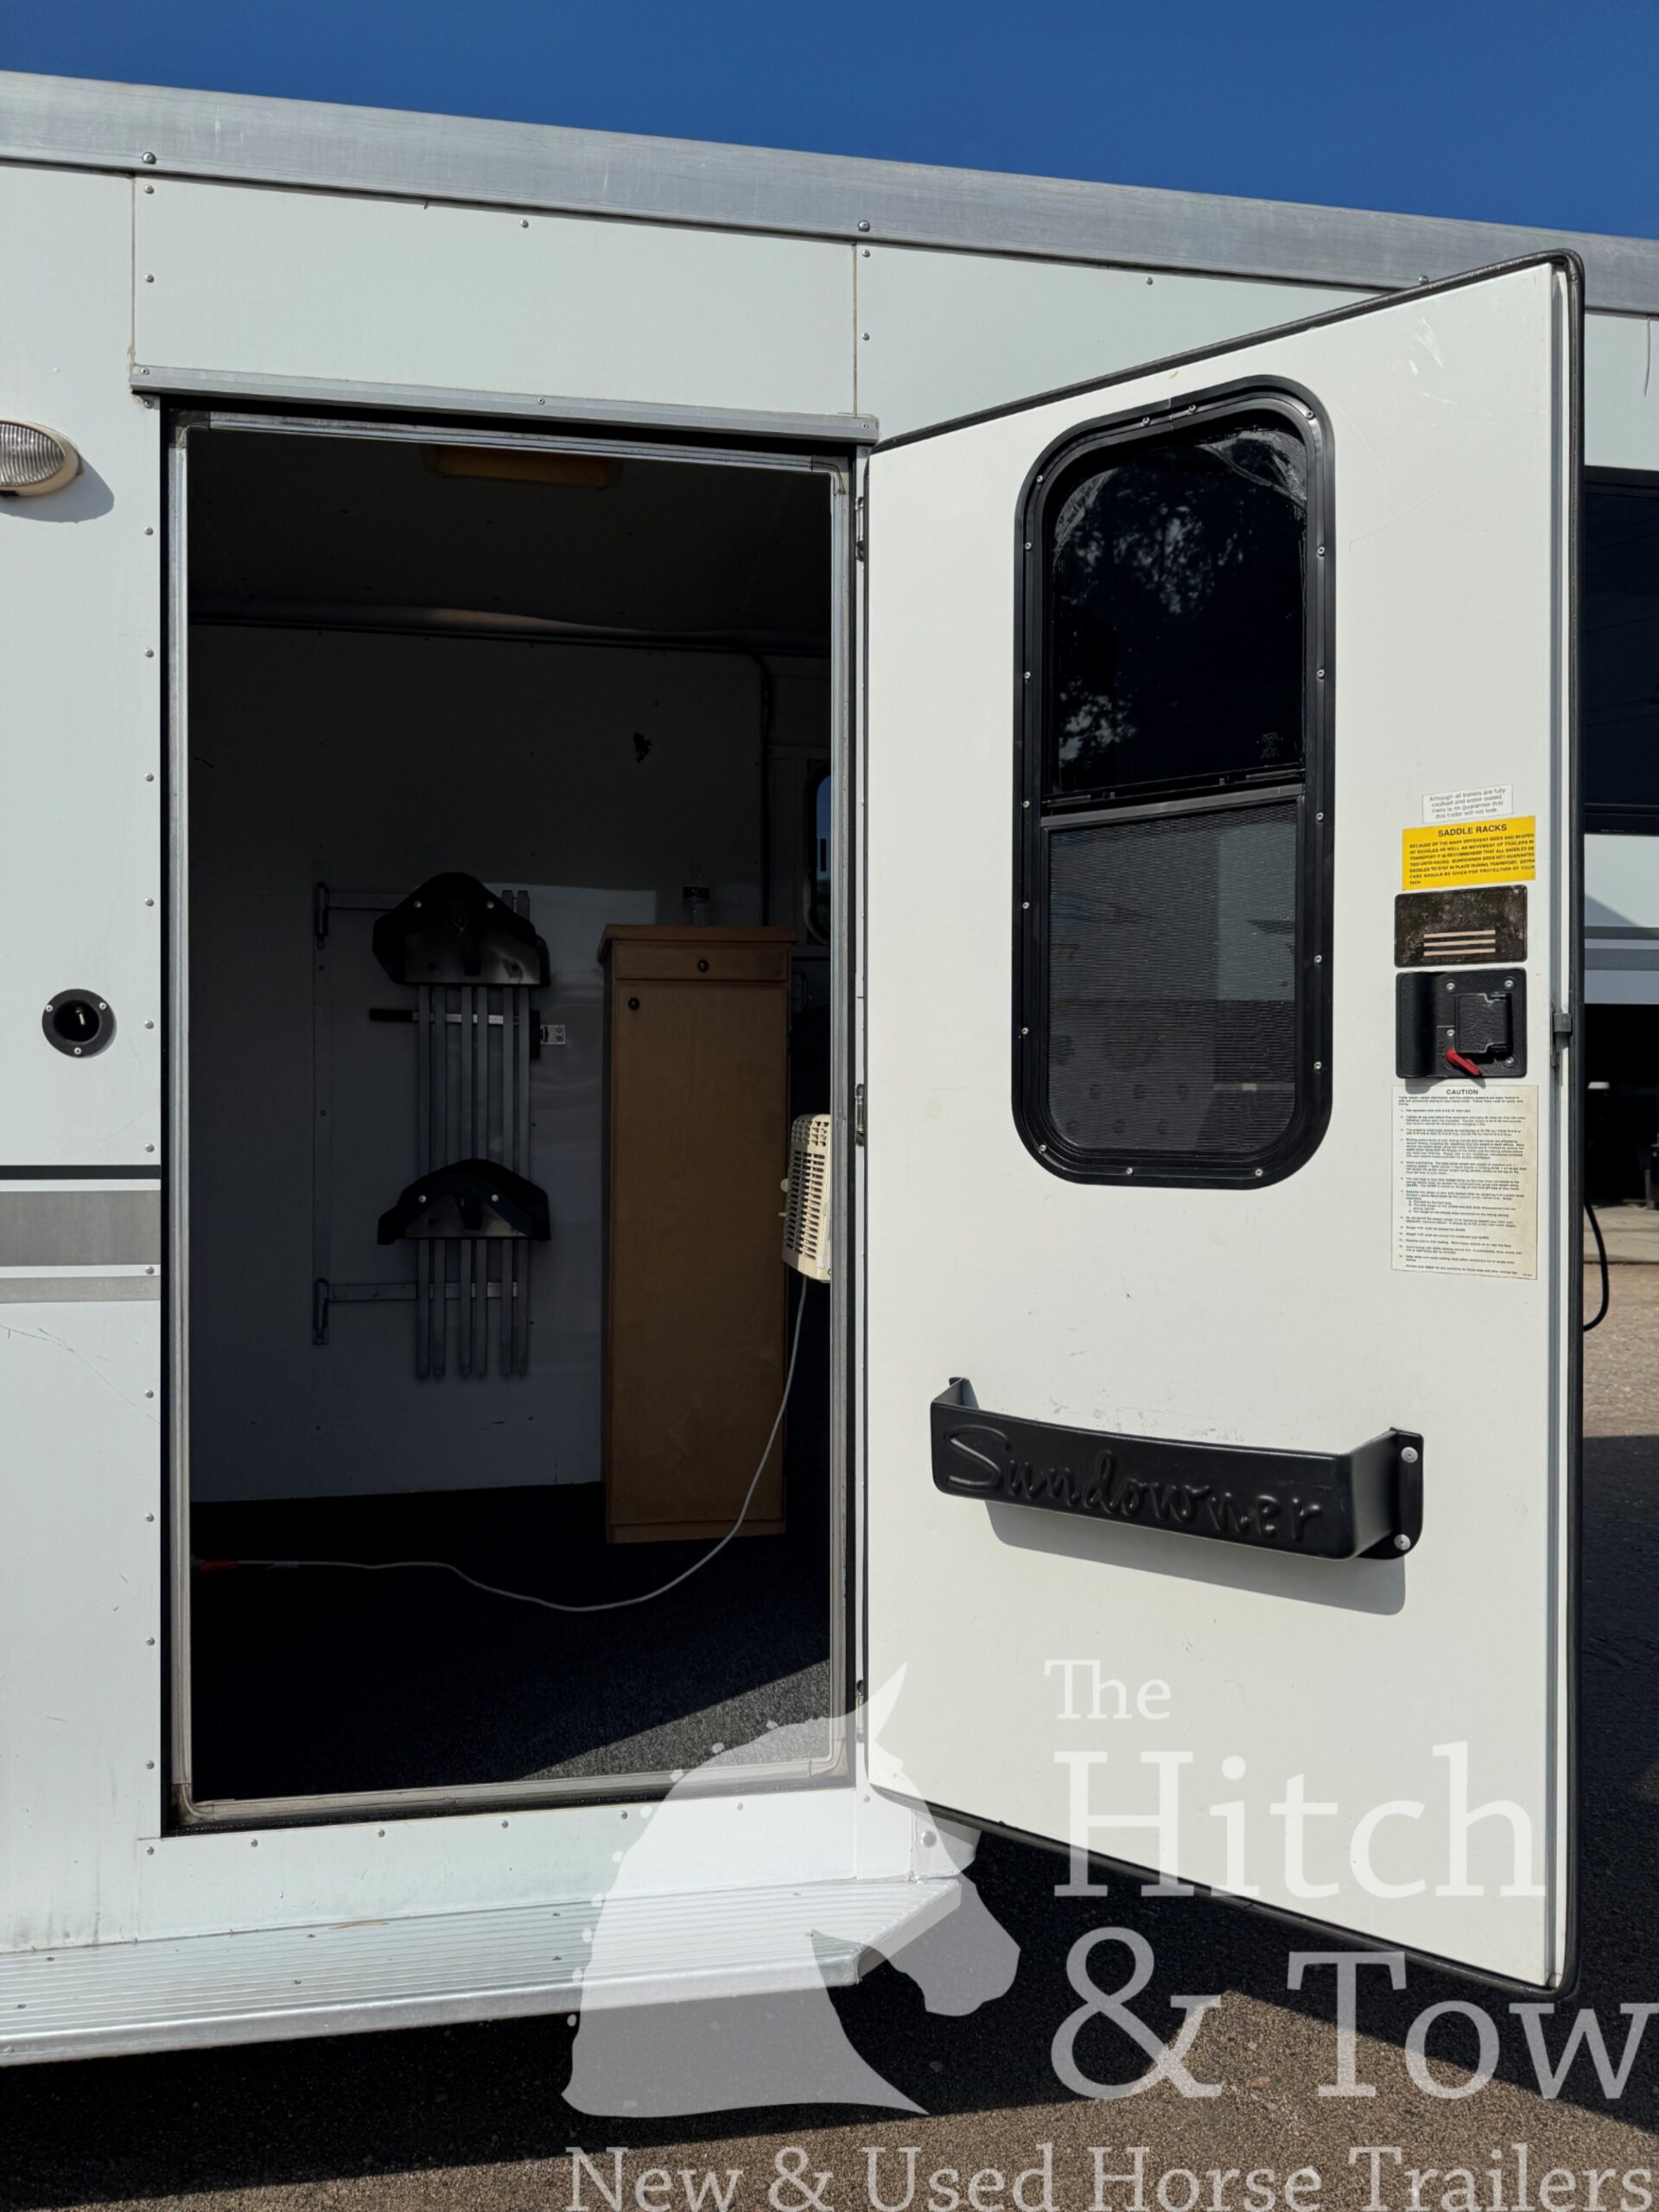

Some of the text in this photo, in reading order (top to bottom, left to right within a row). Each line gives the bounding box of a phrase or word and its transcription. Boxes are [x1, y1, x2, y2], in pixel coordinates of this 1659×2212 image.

[1438, 823, 1507, 837] SADDLE RACKS
[944, 1423, 1324, 1541] Sundowner
